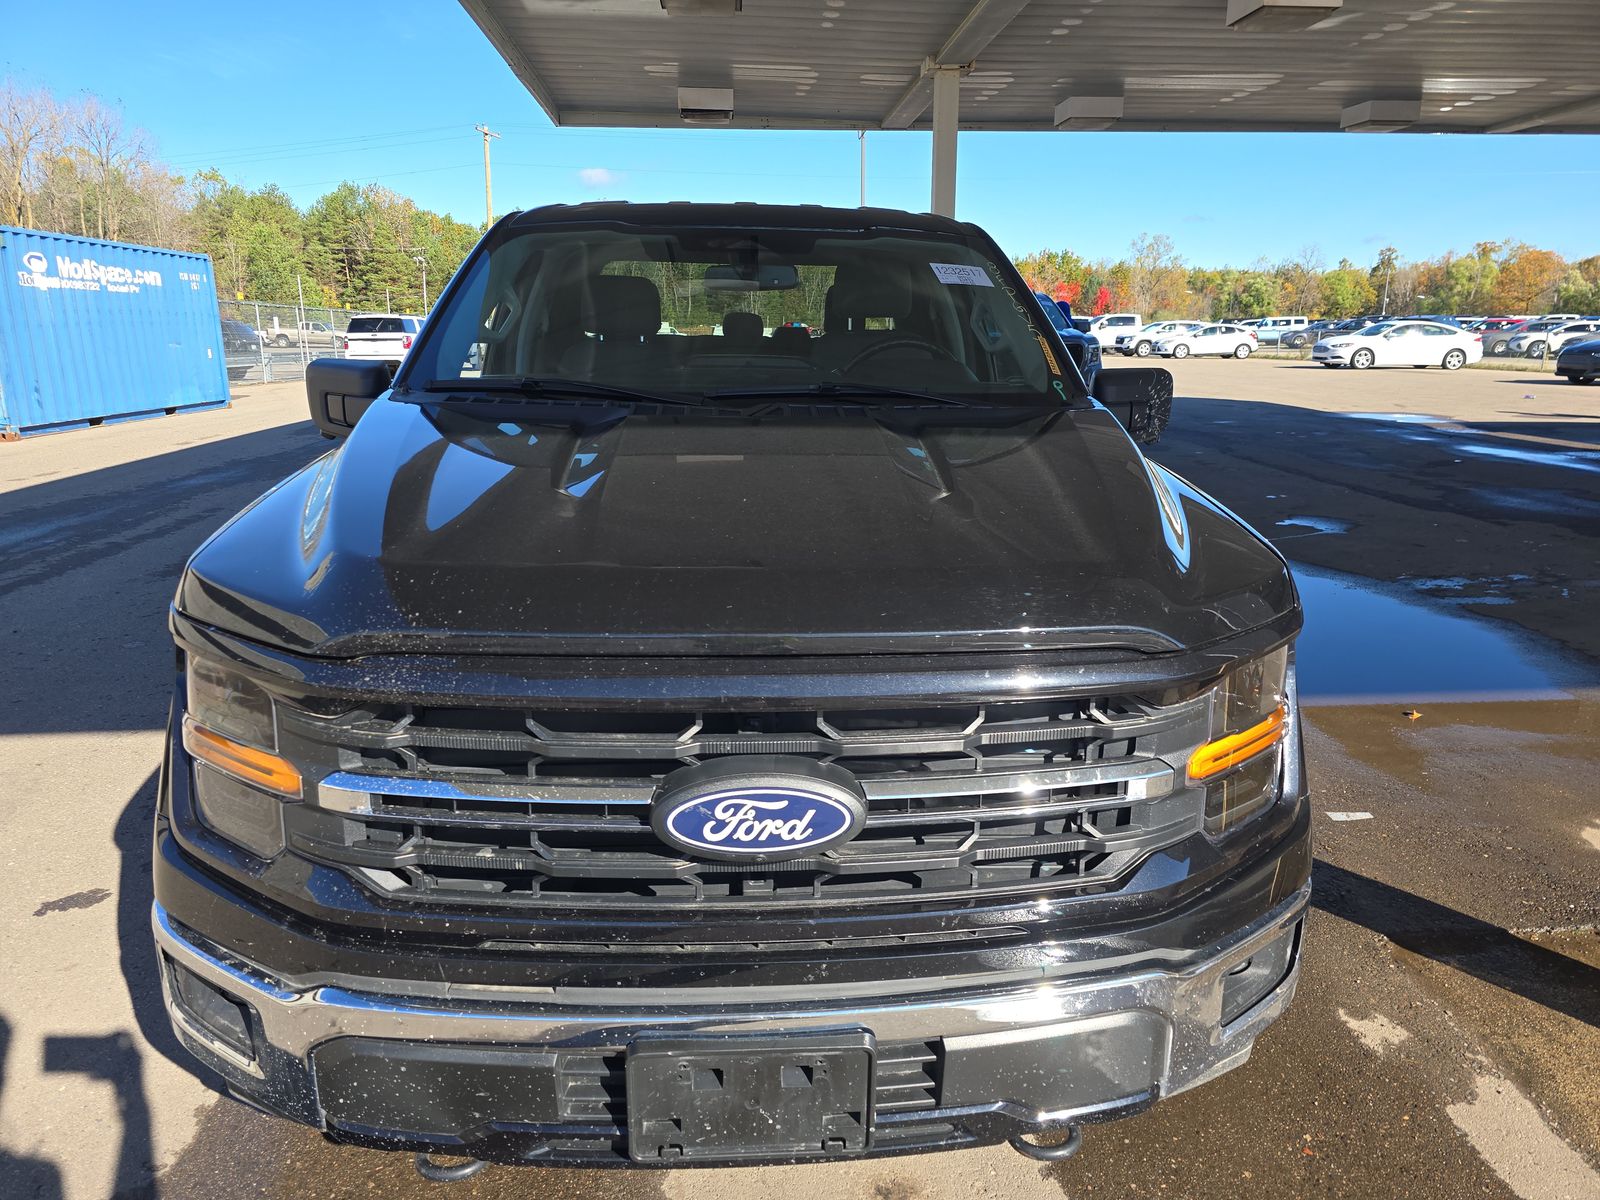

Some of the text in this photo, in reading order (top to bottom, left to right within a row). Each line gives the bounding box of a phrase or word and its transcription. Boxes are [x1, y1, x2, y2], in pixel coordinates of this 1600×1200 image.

[56, 256, 162, 286] ModSpace.com
[936, 266, 982, 277] 1232517
[702, 799, 817, 842] Ford
